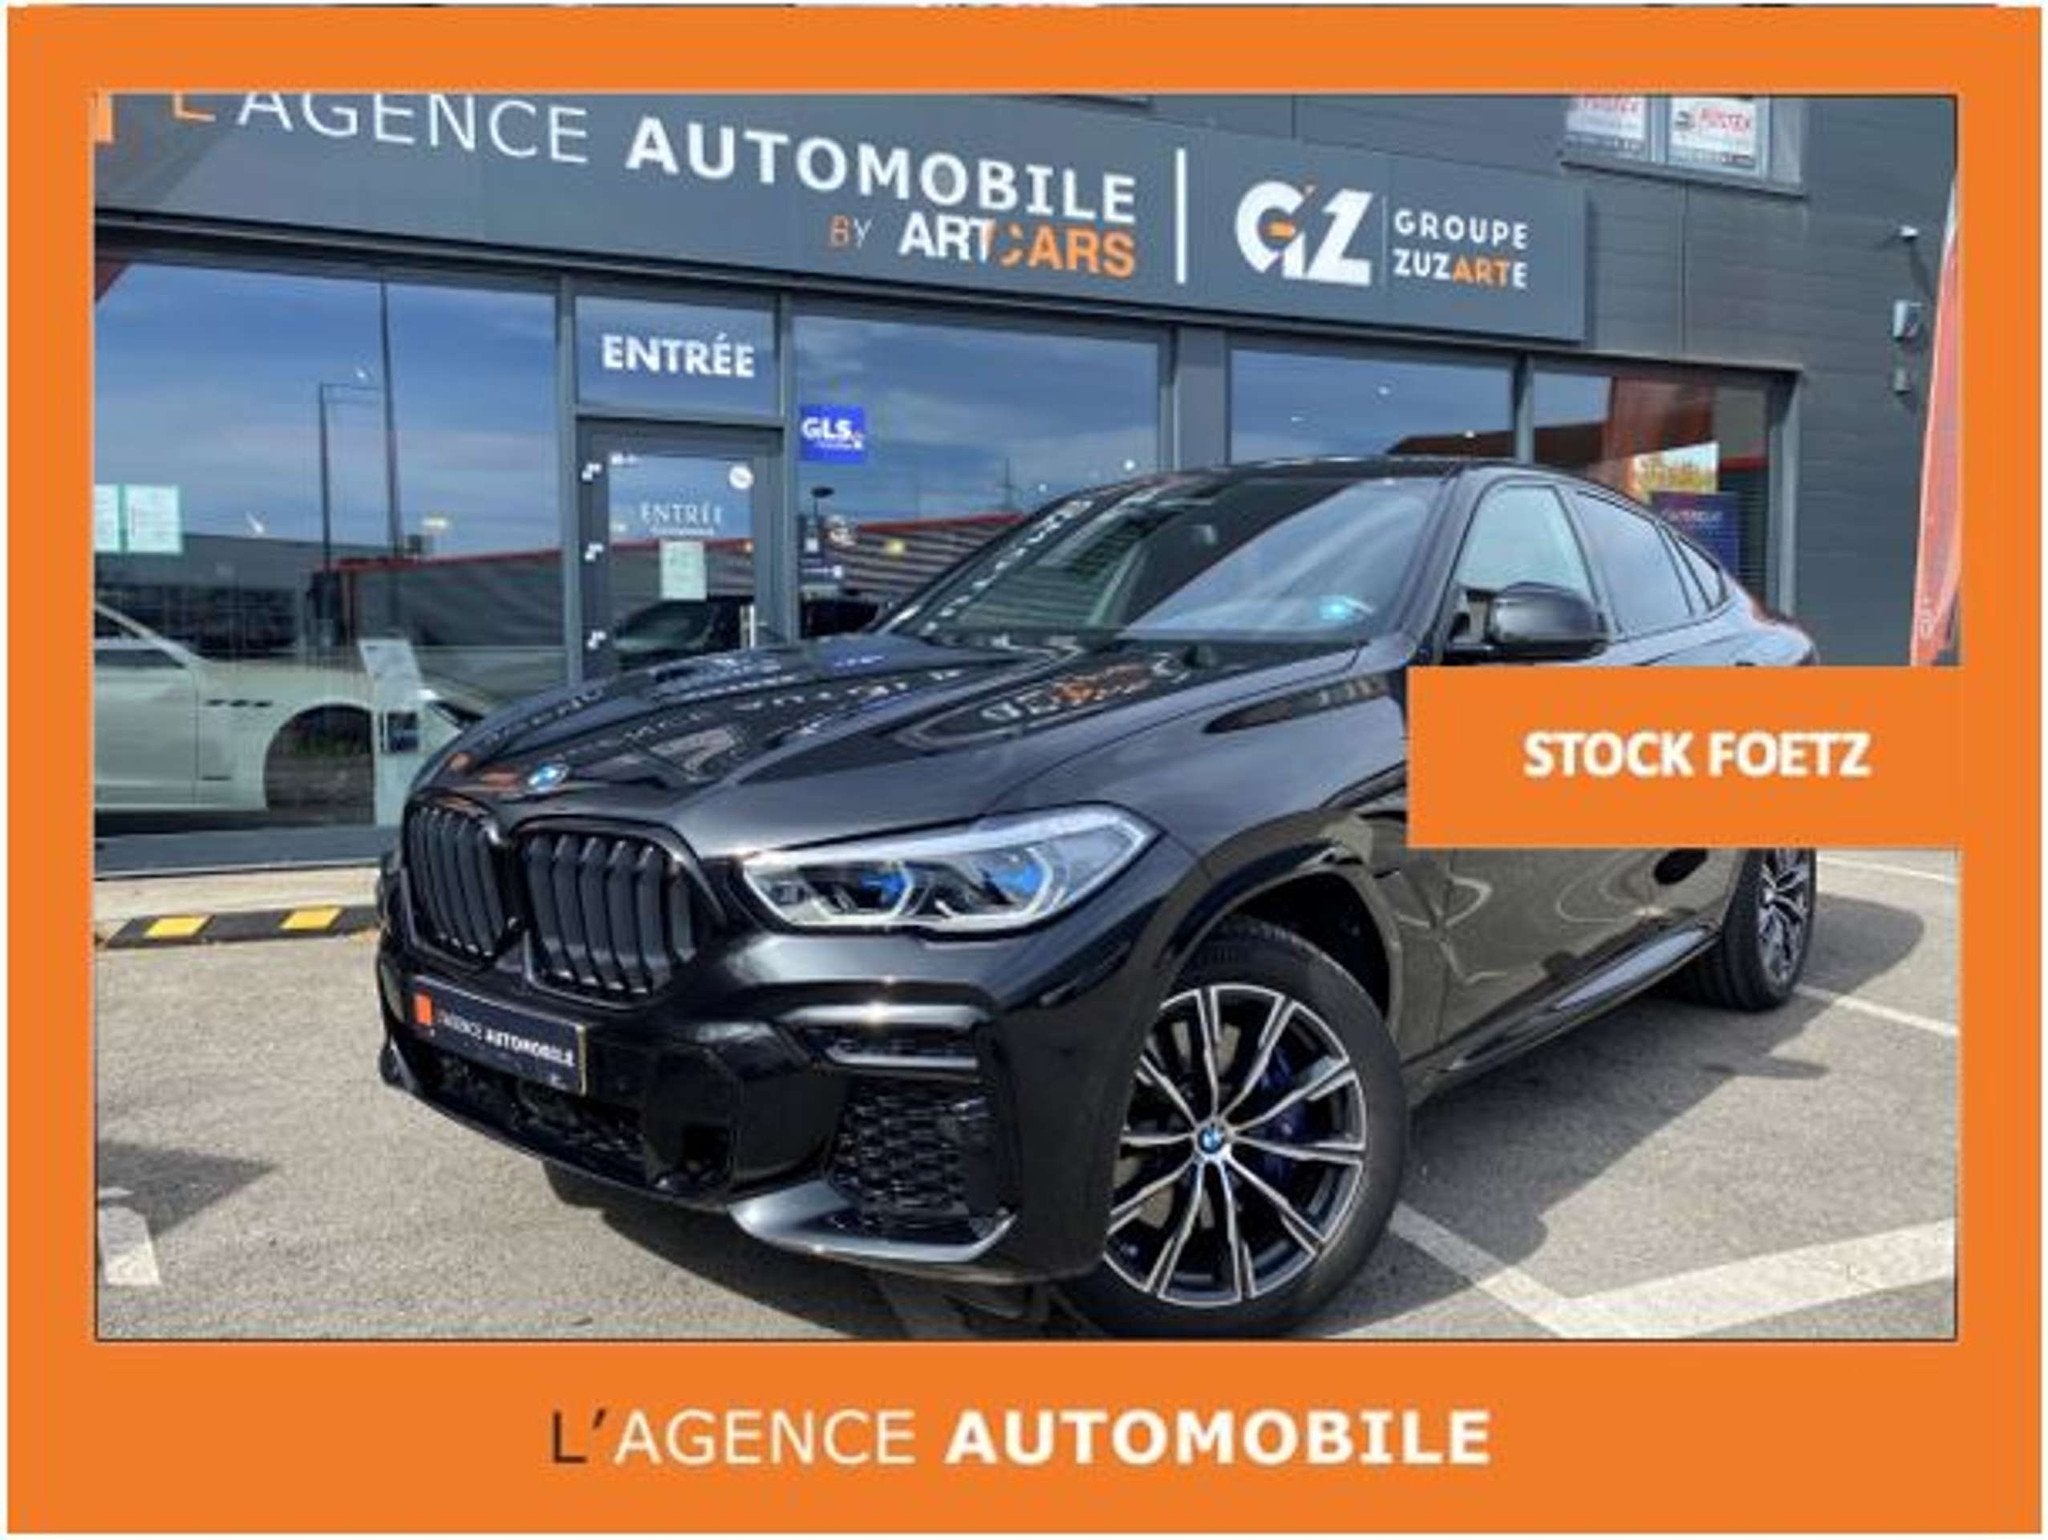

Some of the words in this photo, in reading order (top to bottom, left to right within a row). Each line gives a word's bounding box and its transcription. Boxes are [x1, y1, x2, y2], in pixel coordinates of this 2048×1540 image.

[625, 115, 1137, 225] AUTOMOBILE
[829, 213, 872, 250] BY
[1393, 207, 1529, 251] GROUPE
[1392, 248, 1529, 290] ZUZARTE
[601, 331, 756, 380] ENTRÉE
[801, 415, 853, 442] GLS
[484, 1027, 575, 1068] AUTOMOBILE
